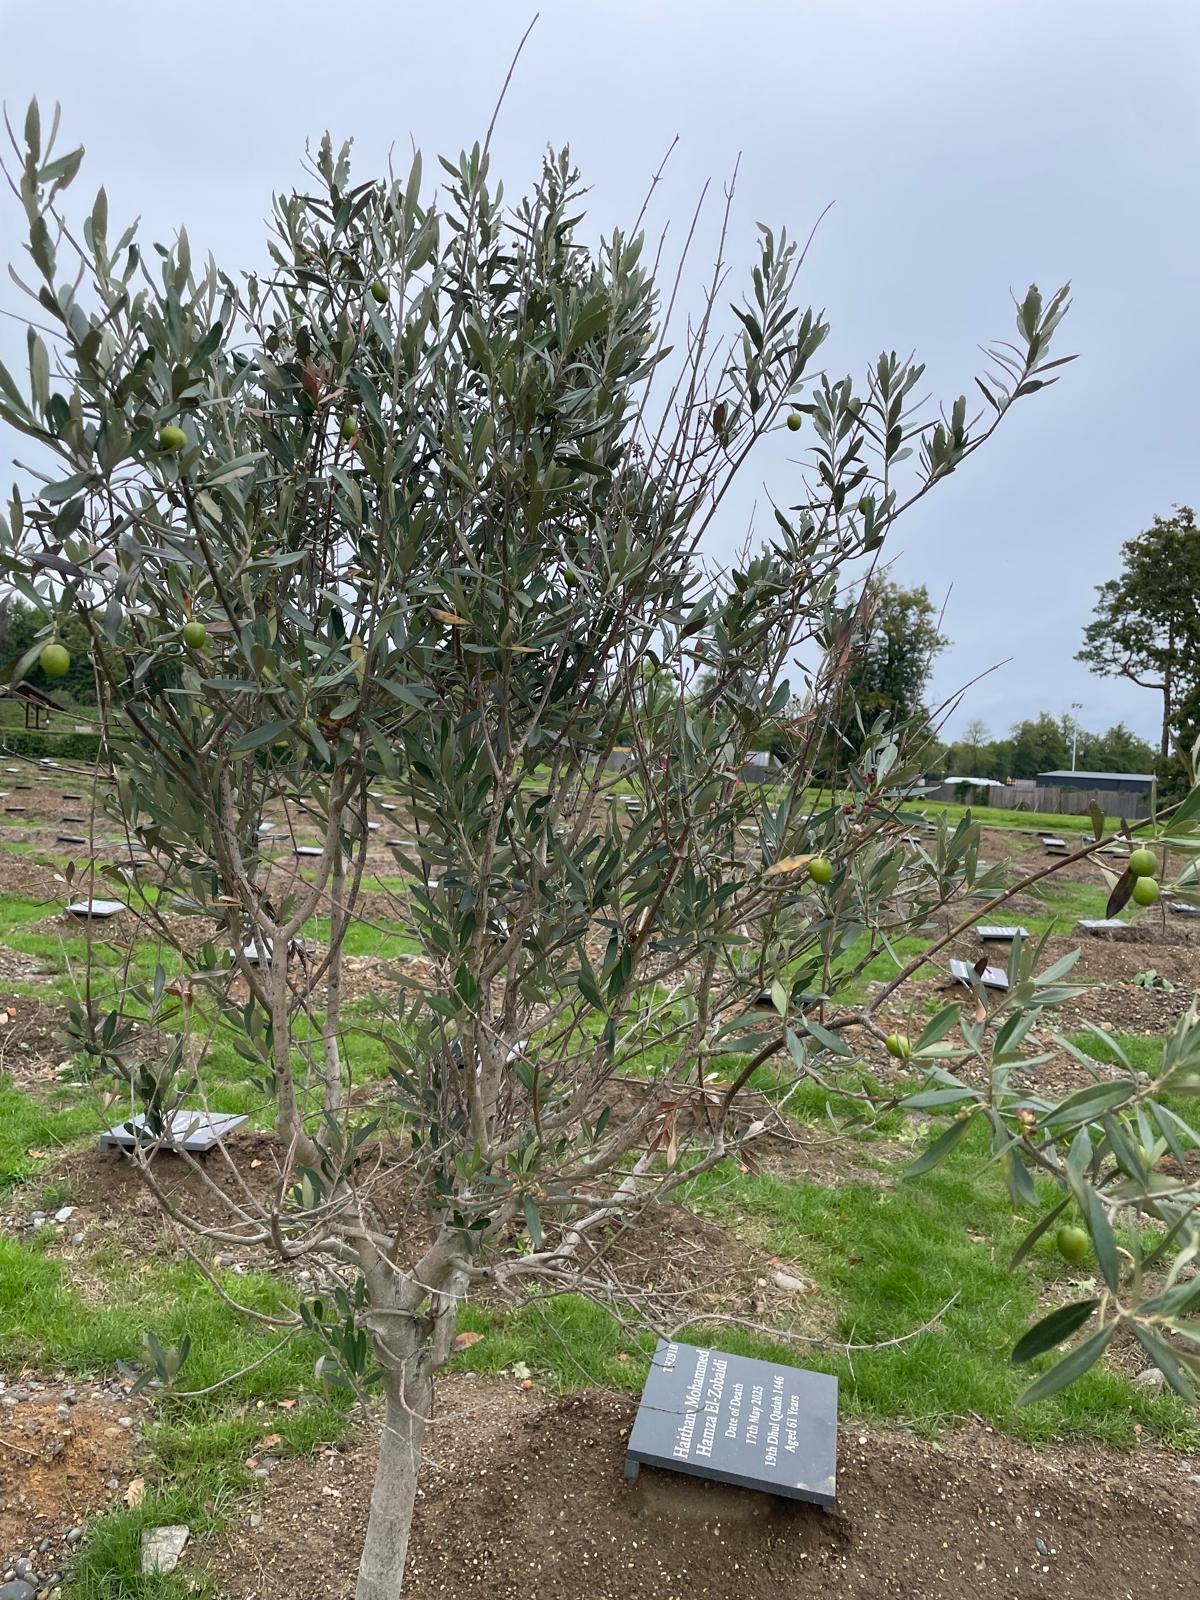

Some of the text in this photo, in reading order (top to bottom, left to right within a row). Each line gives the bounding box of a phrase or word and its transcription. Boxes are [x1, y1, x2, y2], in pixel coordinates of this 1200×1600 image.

[673, 1349, 710, 1459] Haitham Mohammed
[696, 1359, 728, 1458] Hamza El-Zobaidi
[725, 1383, 744, 1438] Date of Death
[746, 1385, 764, 1445] 17th May 2025
[764, 1376, 785, 1466] 19th Dhul Qadah 1446
[784, 1395, 800, 1453] Aged 61 Years
